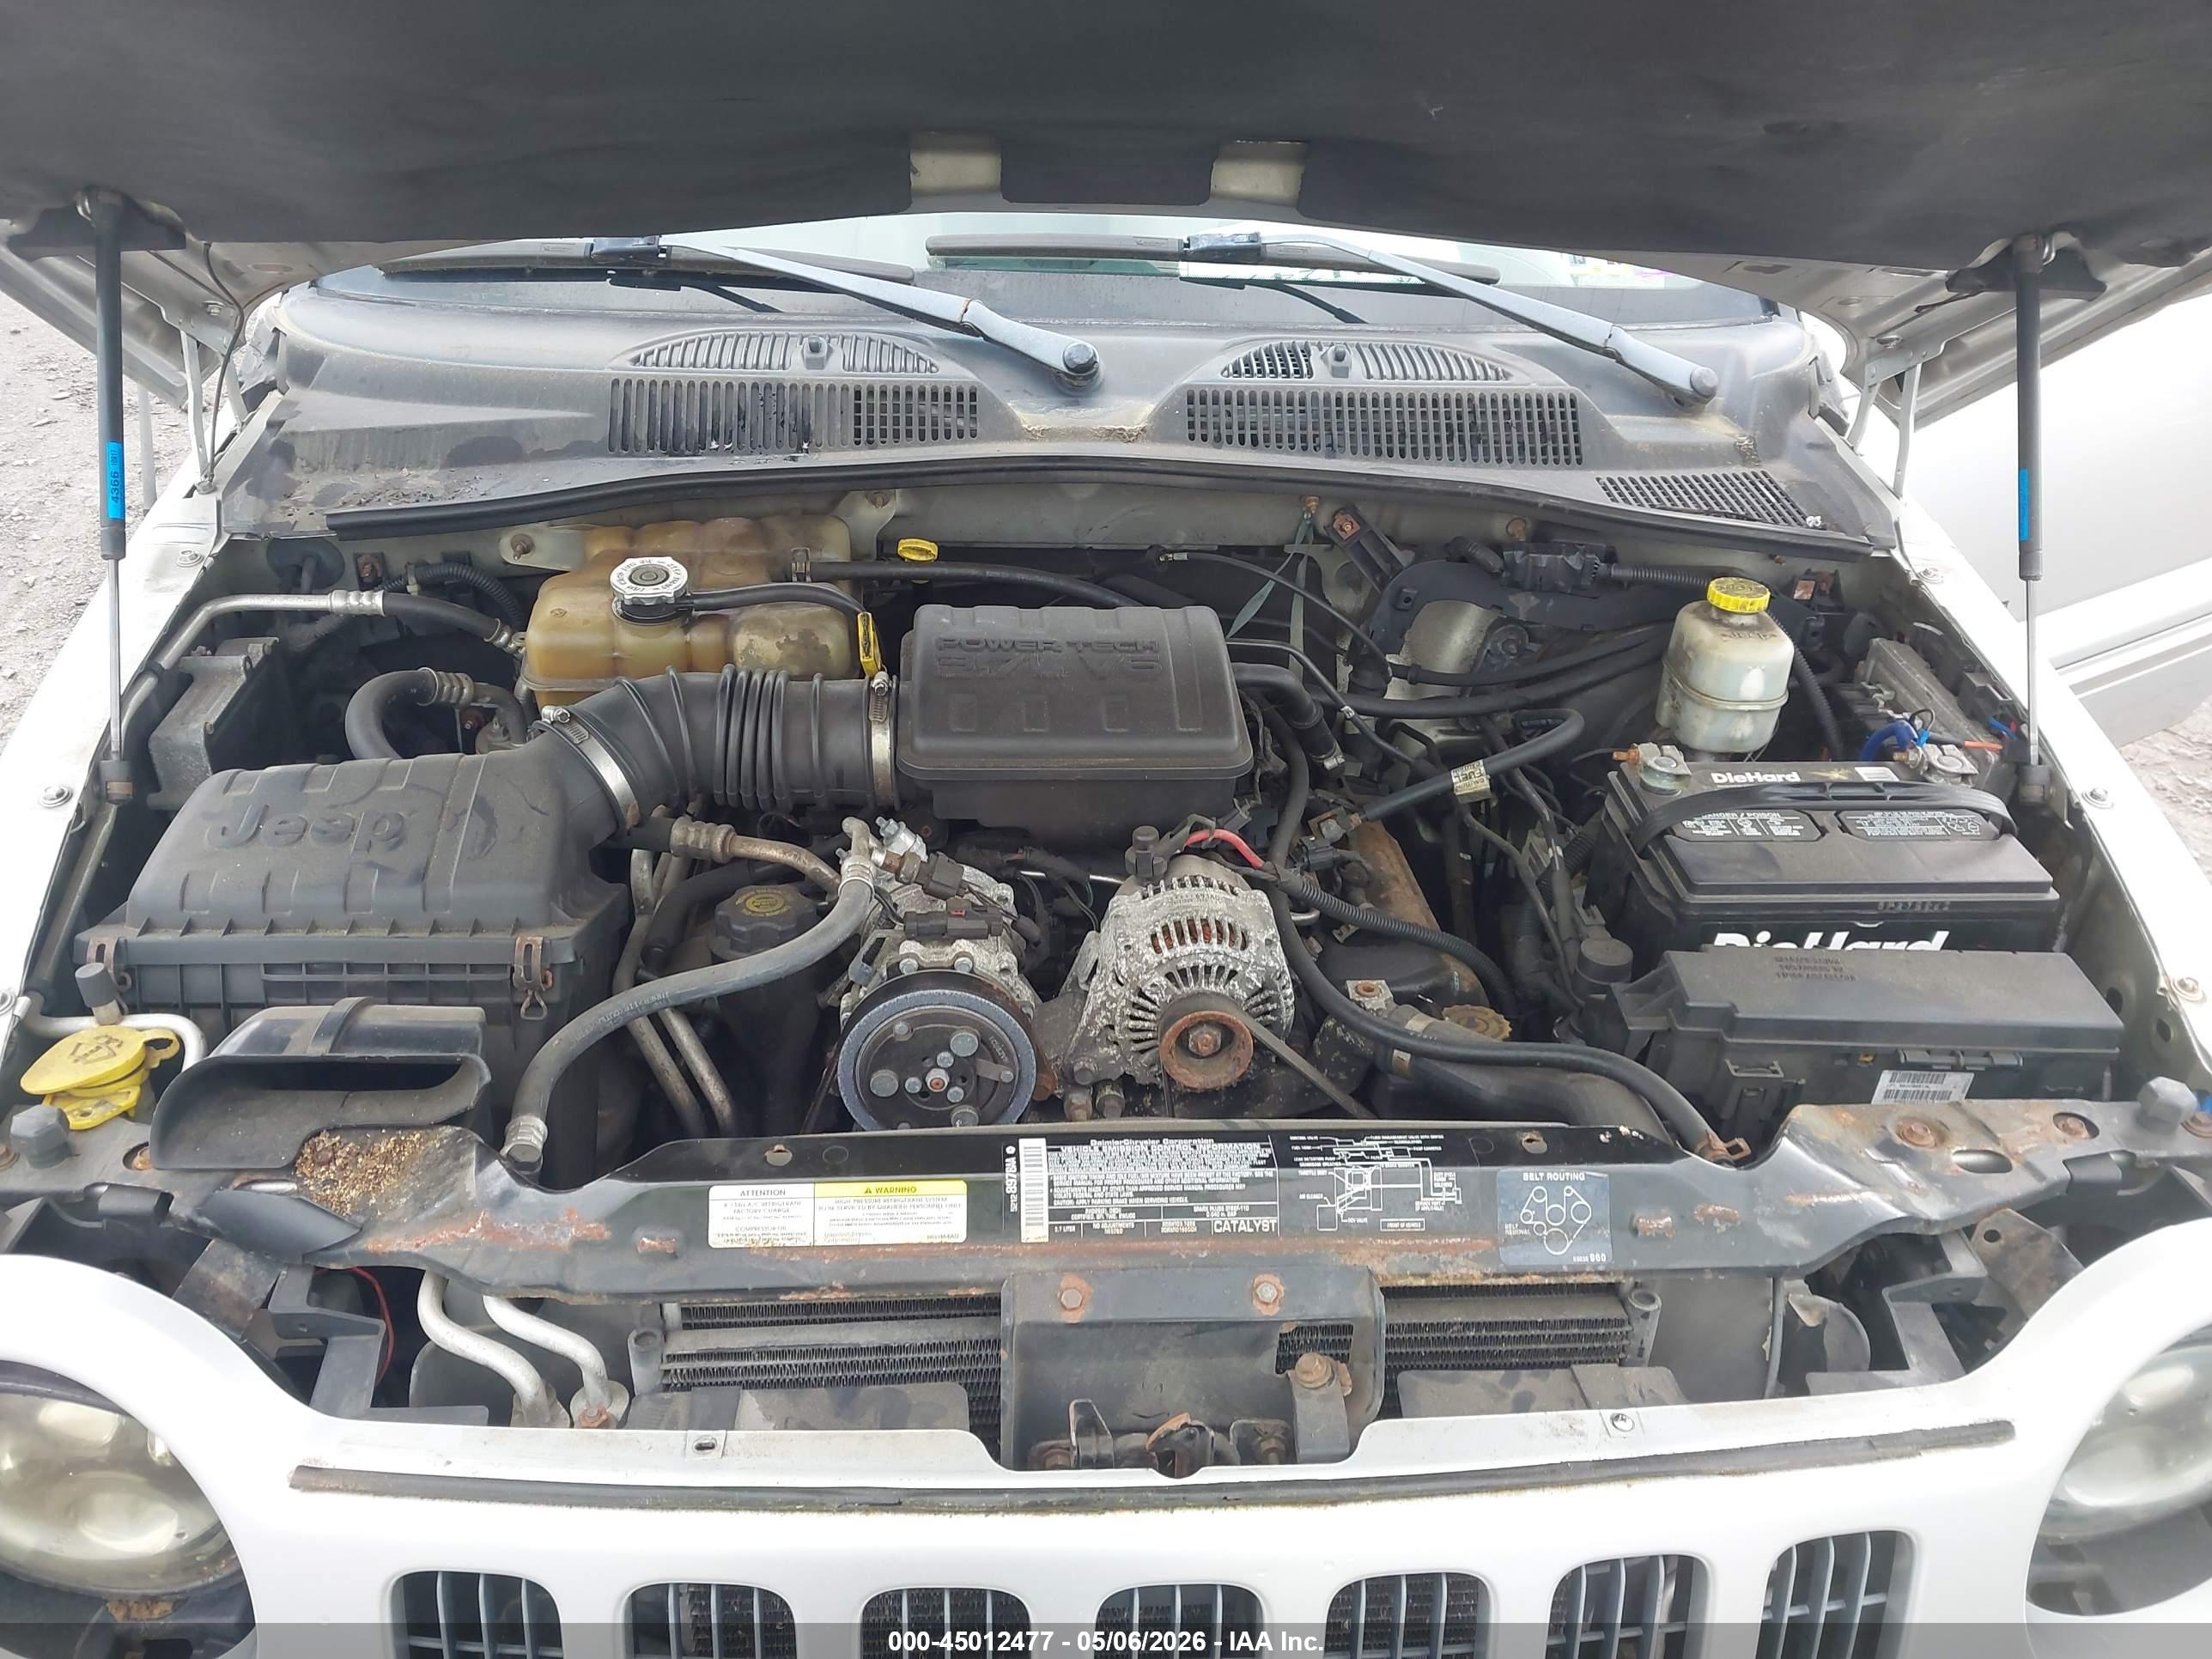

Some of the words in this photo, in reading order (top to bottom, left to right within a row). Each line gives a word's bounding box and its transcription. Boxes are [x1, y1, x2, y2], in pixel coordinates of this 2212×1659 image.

[111, 471, 119, 503] 4366
[937, 638, 1061, 653] POWER
[1066, 640, 1160, 653] TECH
[1454, 769, 1483, 783] FUEL
[1711, 772, 1801, 783] DieHard
[205, 803, 406, 854] Jeep
[1522, 1172, 1545, 1181] BELT
[1547, 1172, 1585, 1181] ROUTING
[740, 1188, 786, 1197] ATTENTION
[1213, 1219, 1277, 1233] CATALYST
